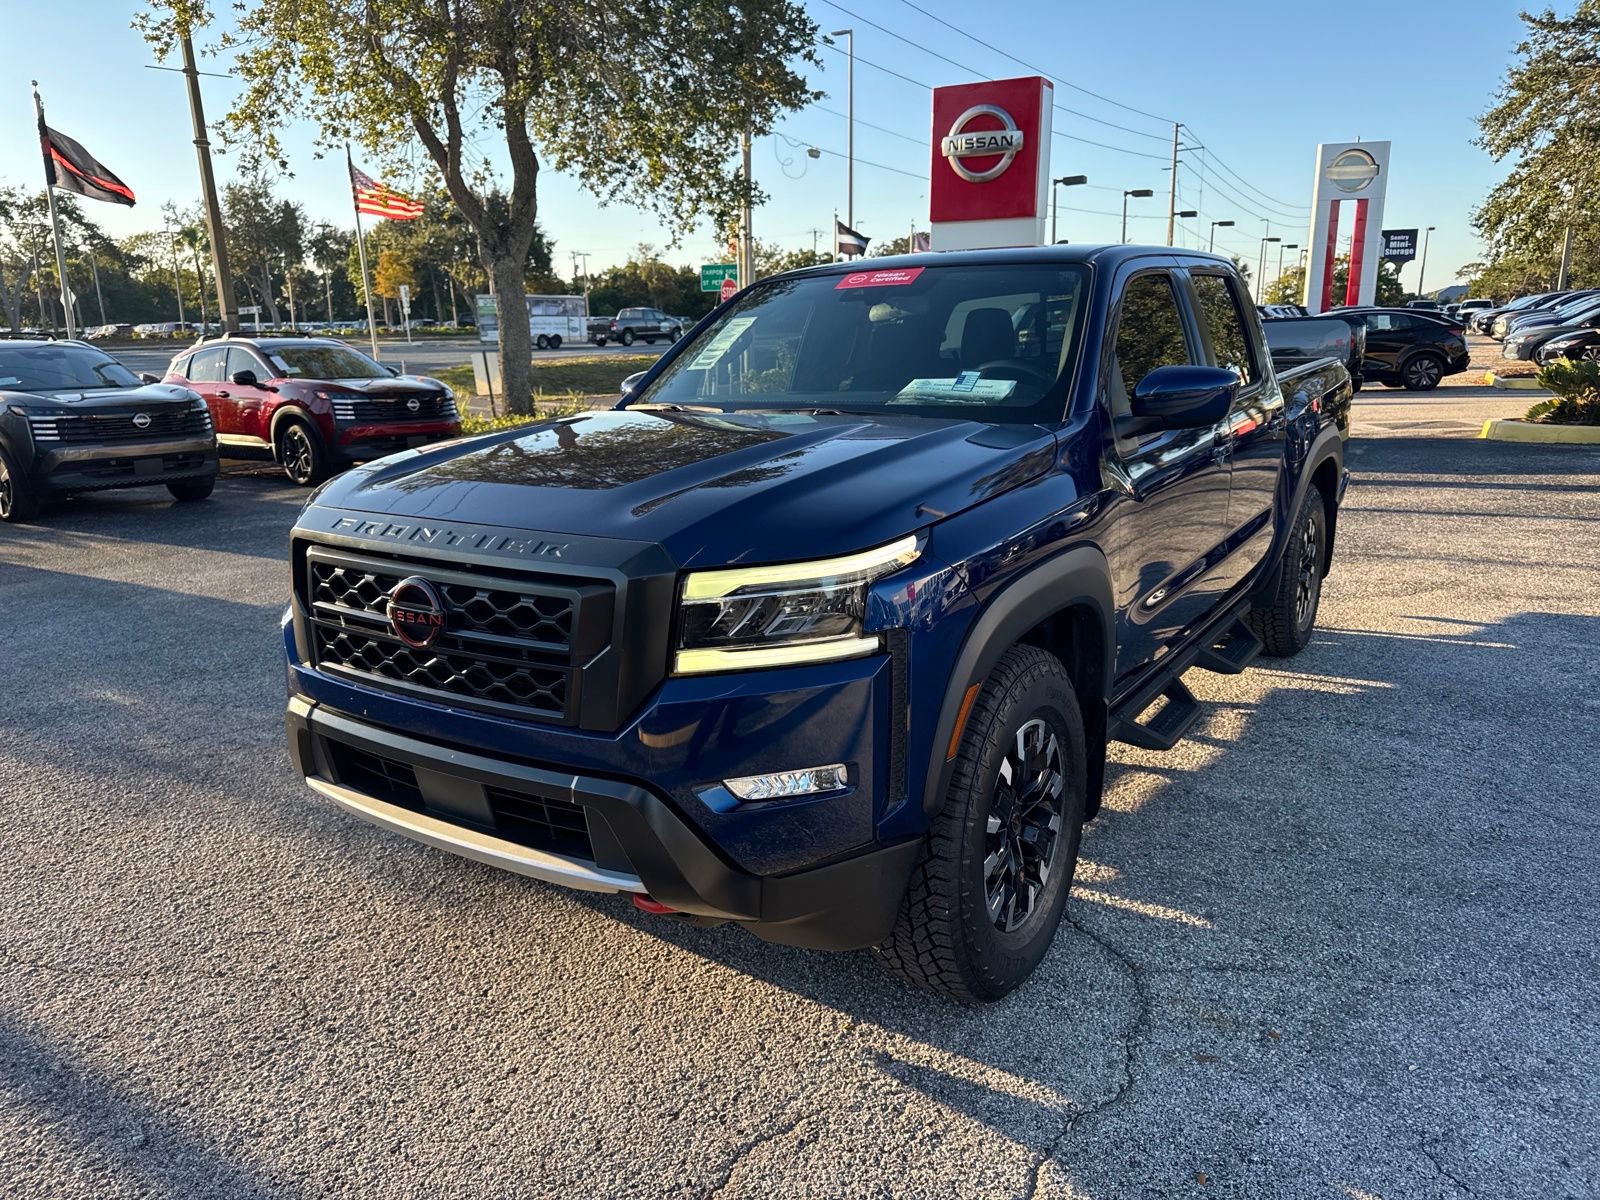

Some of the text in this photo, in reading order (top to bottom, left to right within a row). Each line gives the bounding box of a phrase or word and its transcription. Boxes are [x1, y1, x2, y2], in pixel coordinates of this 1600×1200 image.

[948, 134, 1014, 152] NISSAN
[1384, 248, 1415, 256] Storage
[870, 275, 911, 283] Certified
[331, 516, 569, 558] FRONTIER
[391, 608, 443, 626] ISSAN
